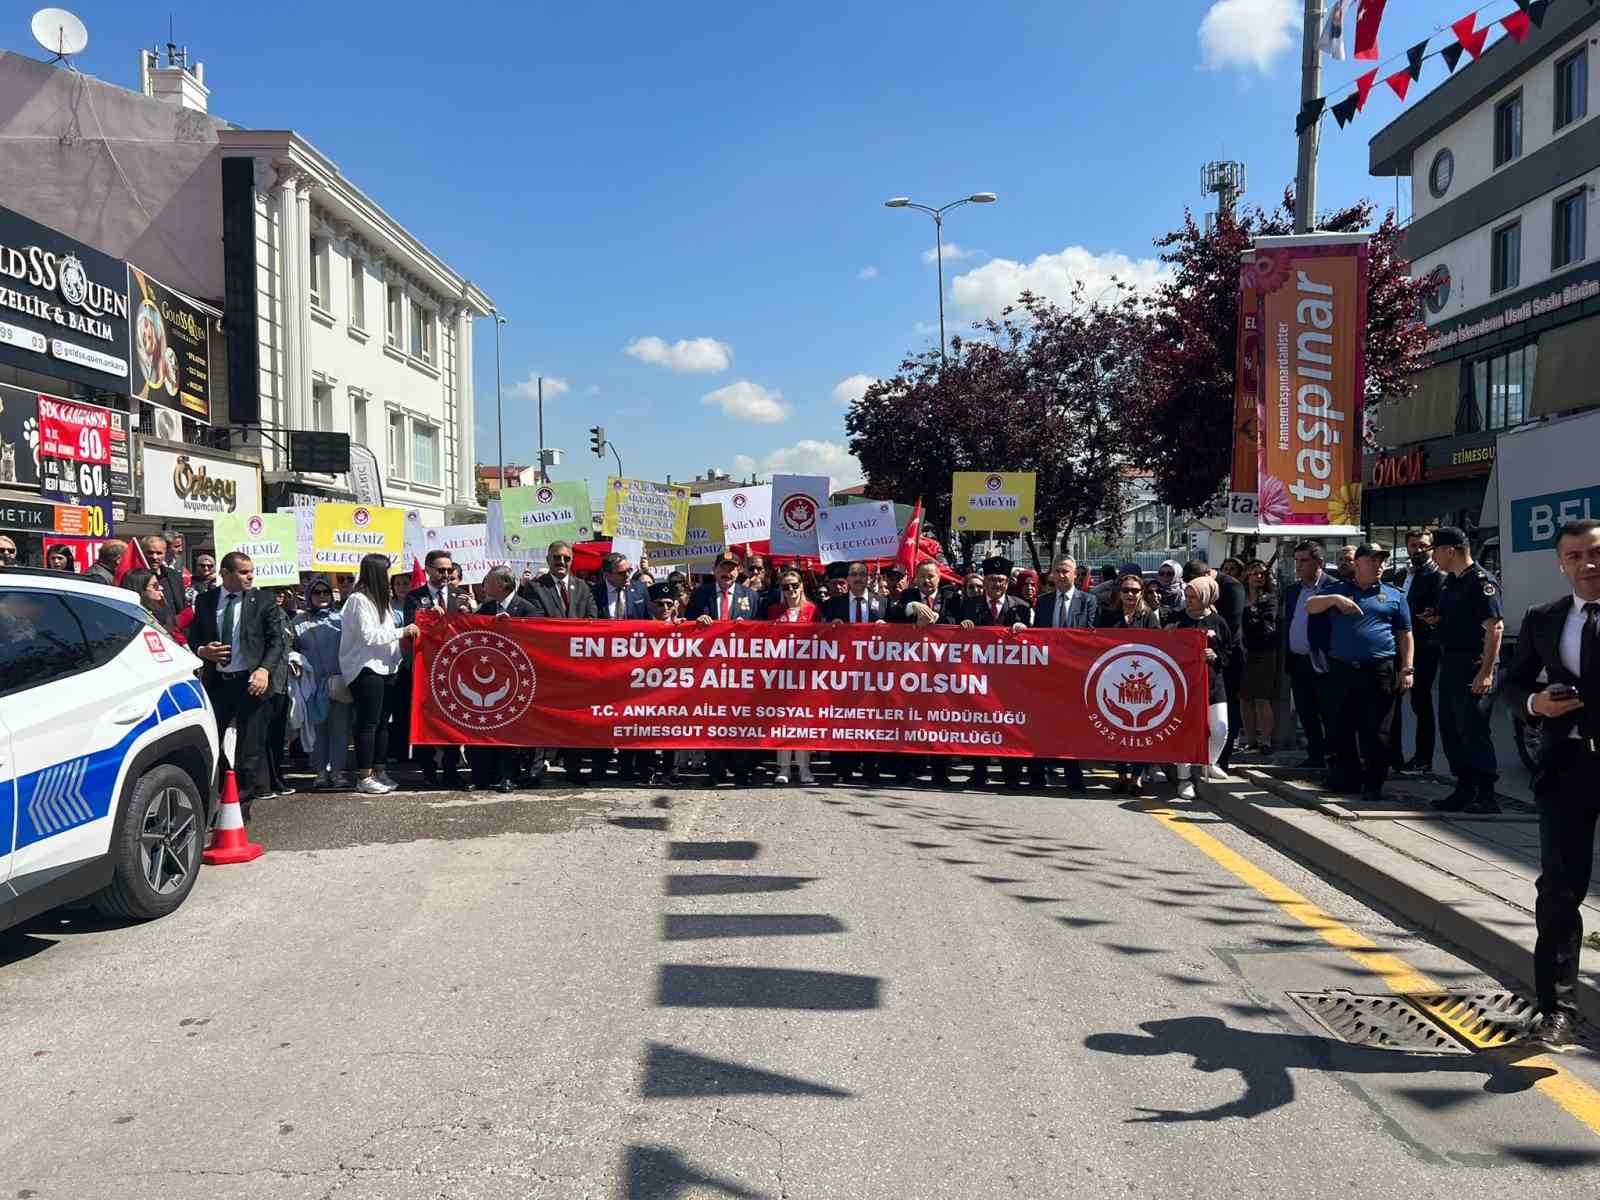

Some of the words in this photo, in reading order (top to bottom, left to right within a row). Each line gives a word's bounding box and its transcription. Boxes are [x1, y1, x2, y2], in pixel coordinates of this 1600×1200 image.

[68, 311, 114, 341] BAKIM
[1288, 270, 1345, 502] taşpınar
[570, 637, 605, 658] EN
[611, 632, 704, 659] BÜYÜK
[709, 633, 846, 663] AİLEMİZİN,
[631, 667, 695, 689] 2025
[700, 665, 755, 689] AİLE
[760, 669, 806, 690] YILI
[812, 671, 894, 692] KUTLU
[900, 672, 988, 695] OLSUN
[591, 704, 619, 717] T.C.
[623, 704, 689, 717] ANKARA
[693, 703, 727, 717] AİLE
[731, 705, 751, 717] VE
[756, 705, 815, 719] SOSYAL
[818, 705, 904, 721] HİZMETLER
[908, 706, 923, 721] İL
[927, 707, 1026, 725] MÜDÜRLÜĞÜ
[613, 723, 704, 737] ETİMESGUT
[708, 725, 767, 738] SOSYAL
[770, 726, 829, 740] HİZMET
[832, 726, 900, 742] MERKEZİ
[904, 727, 1003, 745] MÜDÜRLÜĞÜ
